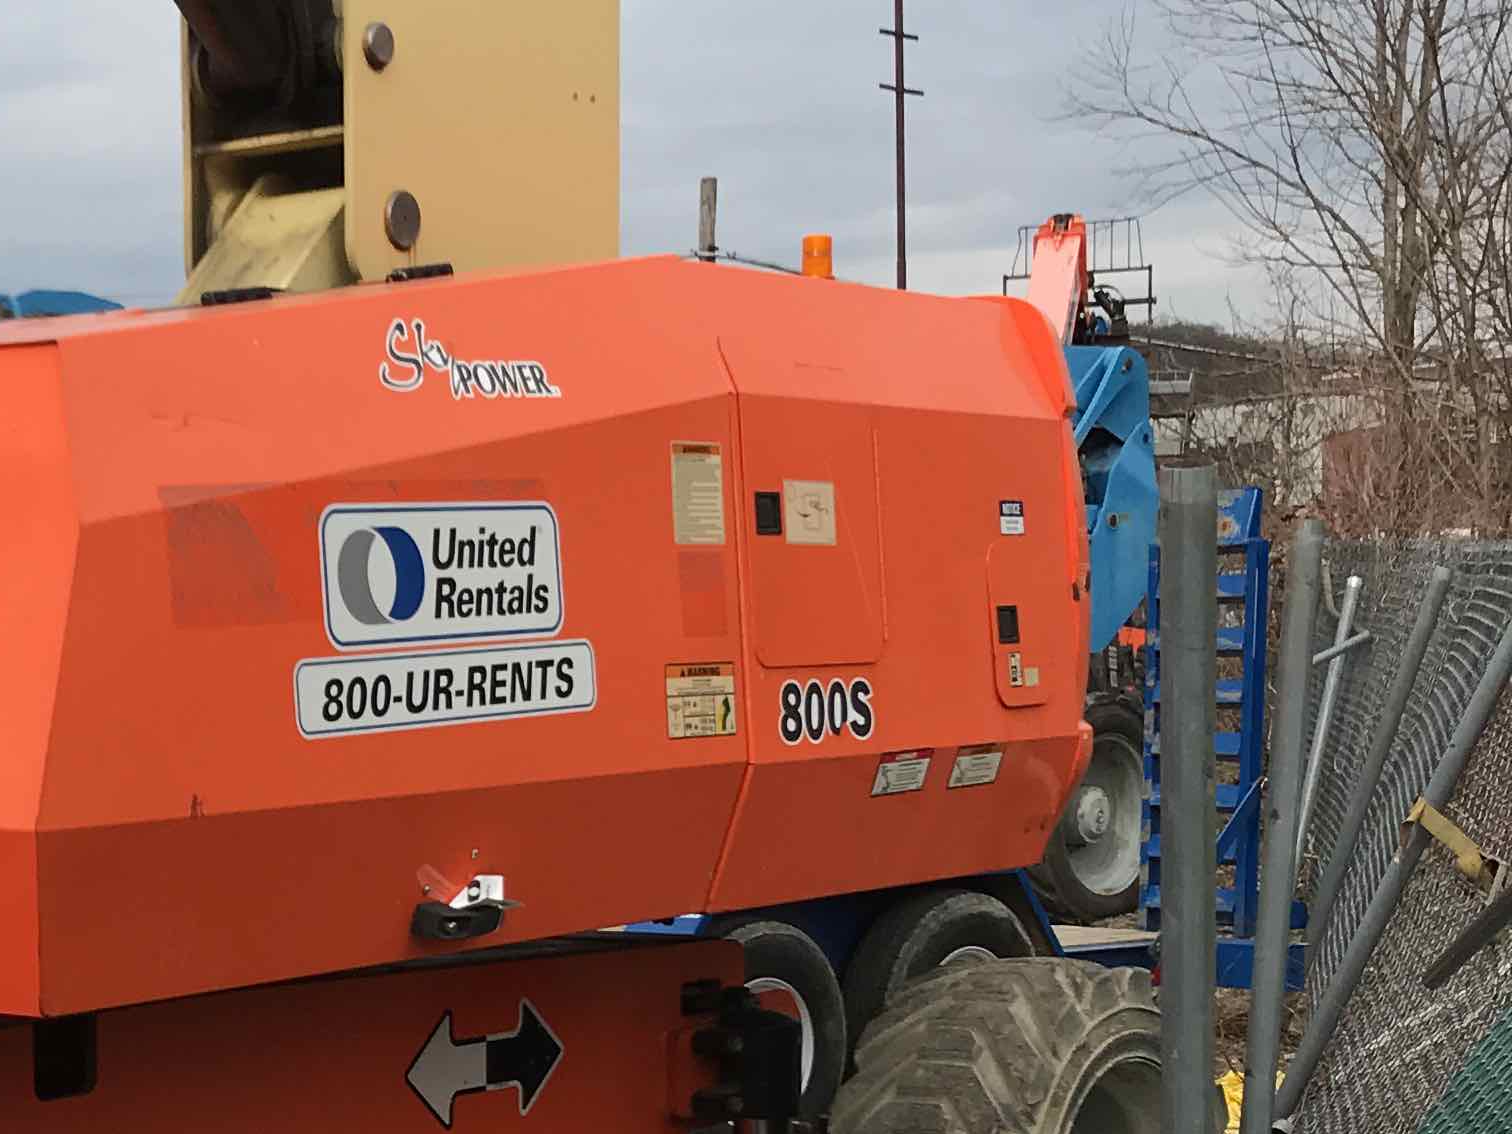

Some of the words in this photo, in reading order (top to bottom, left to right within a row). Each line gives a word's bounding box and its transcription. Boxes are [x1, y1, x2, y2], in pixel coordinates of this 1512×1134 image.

[432, 526, 537, 570] United
[434, 573, 549, 619] Rentals
[322, 657, 575, 722] 800-UR-RENTS
[780, 679, 874, 743] 800S
